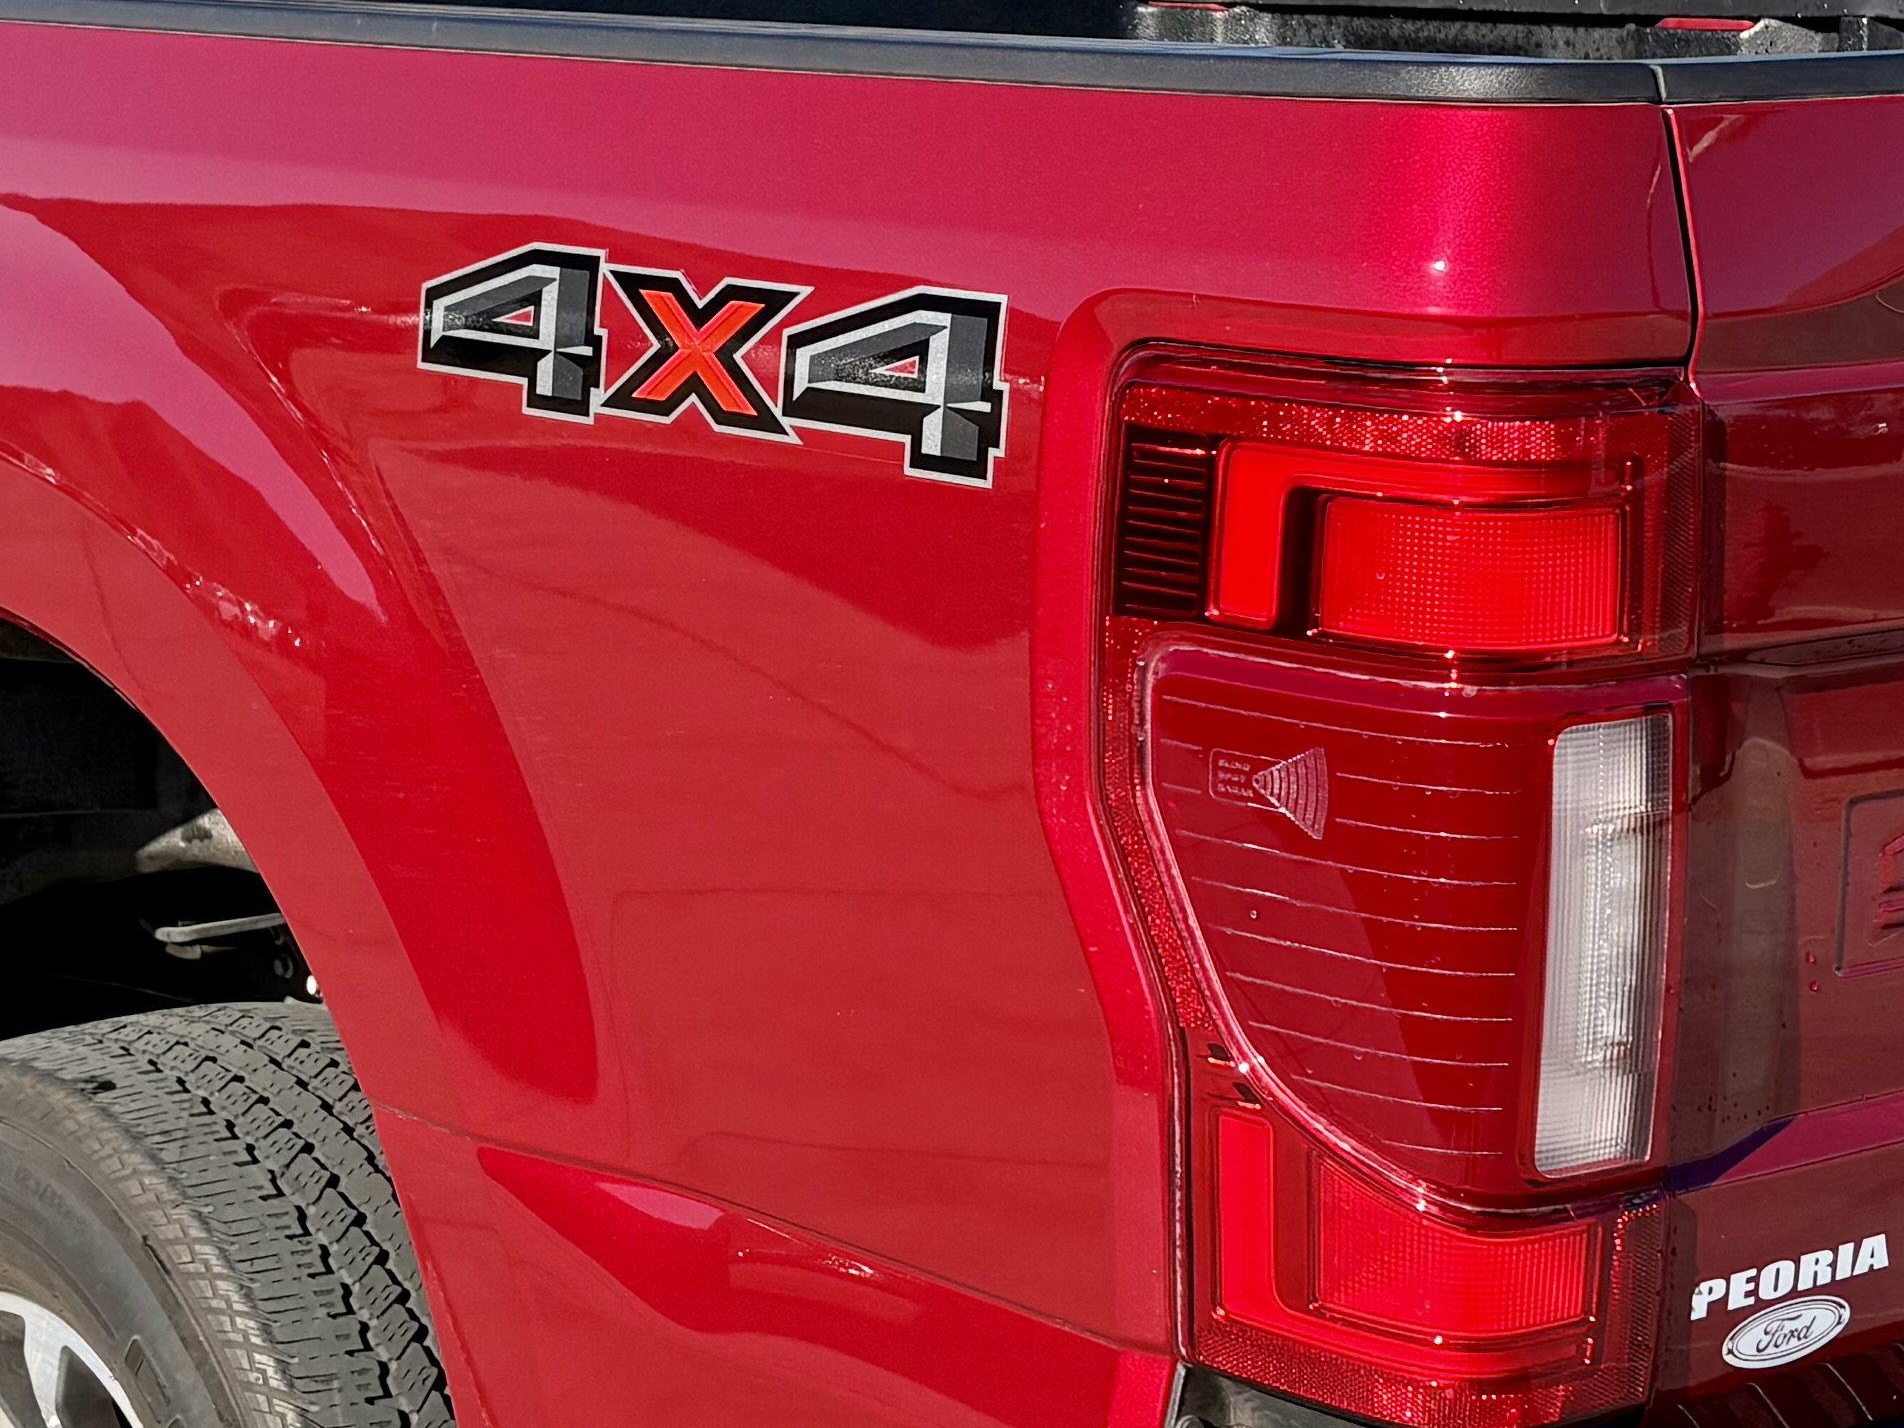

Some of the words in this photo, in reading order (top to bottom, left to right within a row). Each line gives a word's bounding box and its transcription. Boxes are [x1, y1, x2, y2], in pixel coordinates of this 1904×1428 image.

[417, 242, 1008, 488] 4X4
[1690, 1233, 1889, 1321] PEORIA
[1755, 1313, 1817, 1354] Ford
